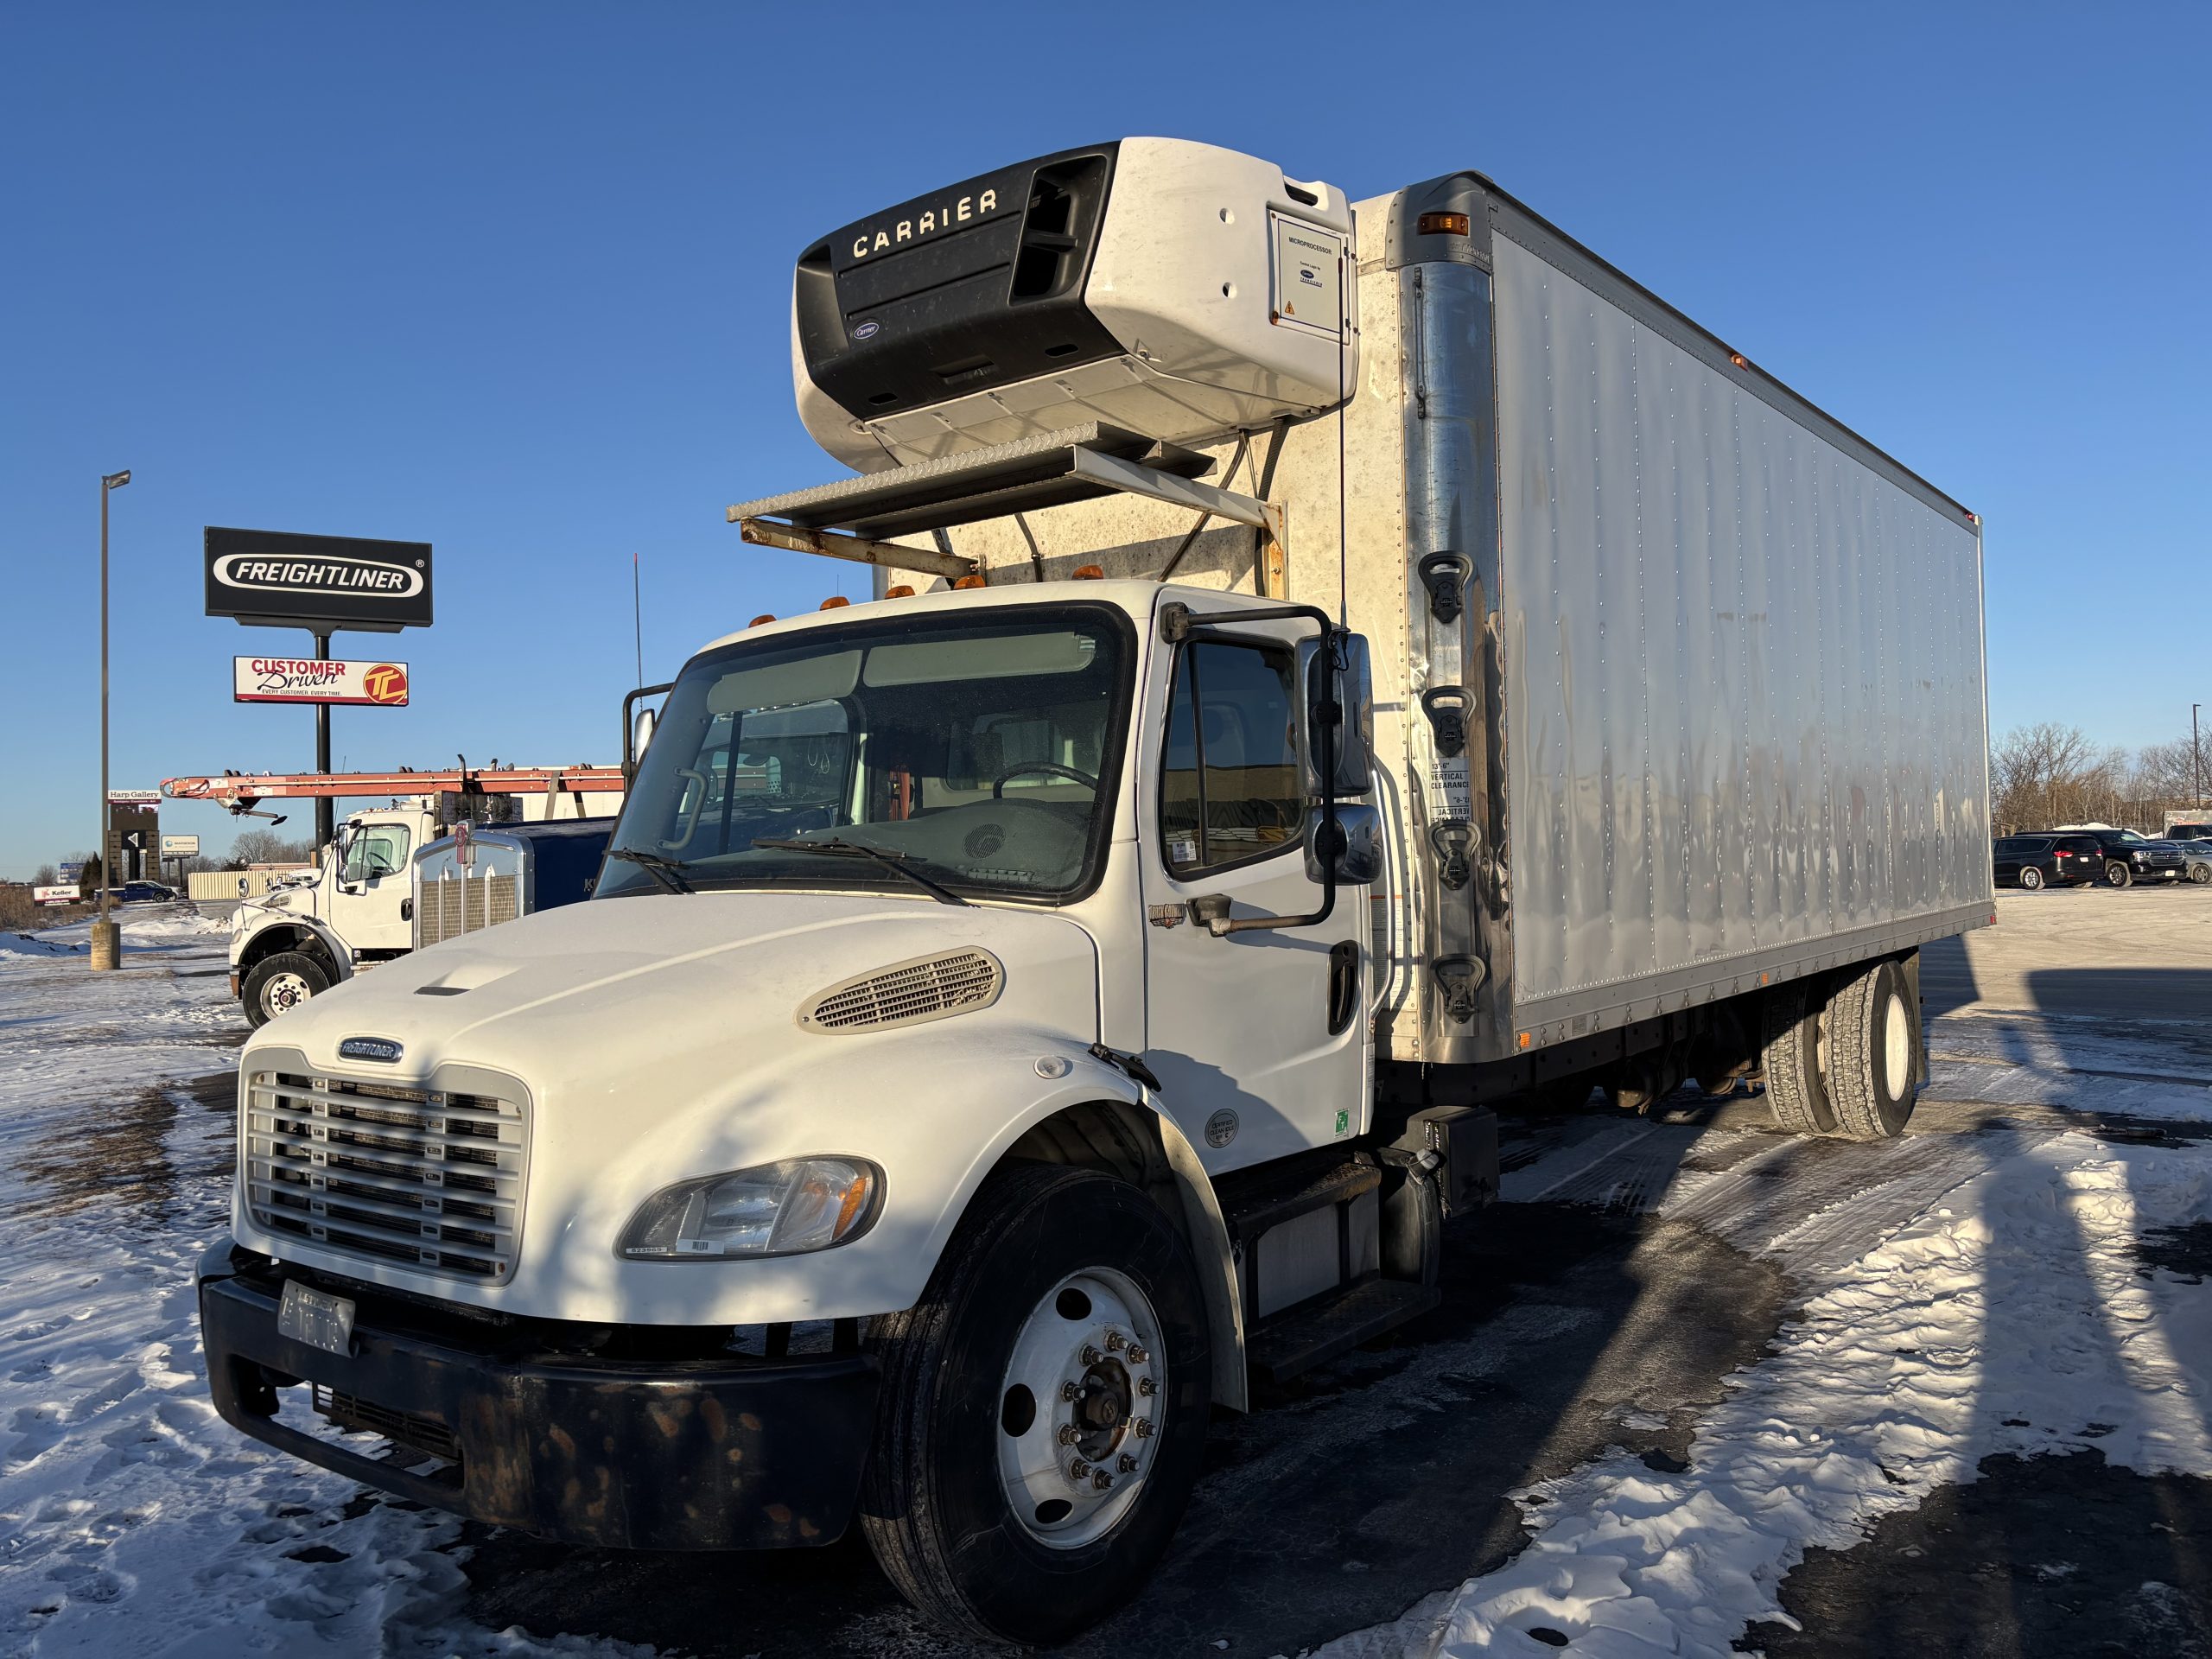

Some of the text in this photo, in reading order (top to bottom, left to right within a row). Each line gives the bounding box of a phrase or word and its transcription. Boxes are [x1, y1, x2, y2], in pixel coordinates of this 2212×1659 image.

[854, 189, 996, 258] CARRIER
[1288, 236, 1332, 255] MICROPROCESSOR
[856, 325, 876, 336] Carrier
[235, 562, 404, 589] FREIGHTLINER
[251, 659, 346, 676] CUSTOMER
[257, 670, 338, 690] Driven
[1431, 772, 1463, 781] VERTICAL
[341, 1042, 394, 1058] FREIGHTLINER
